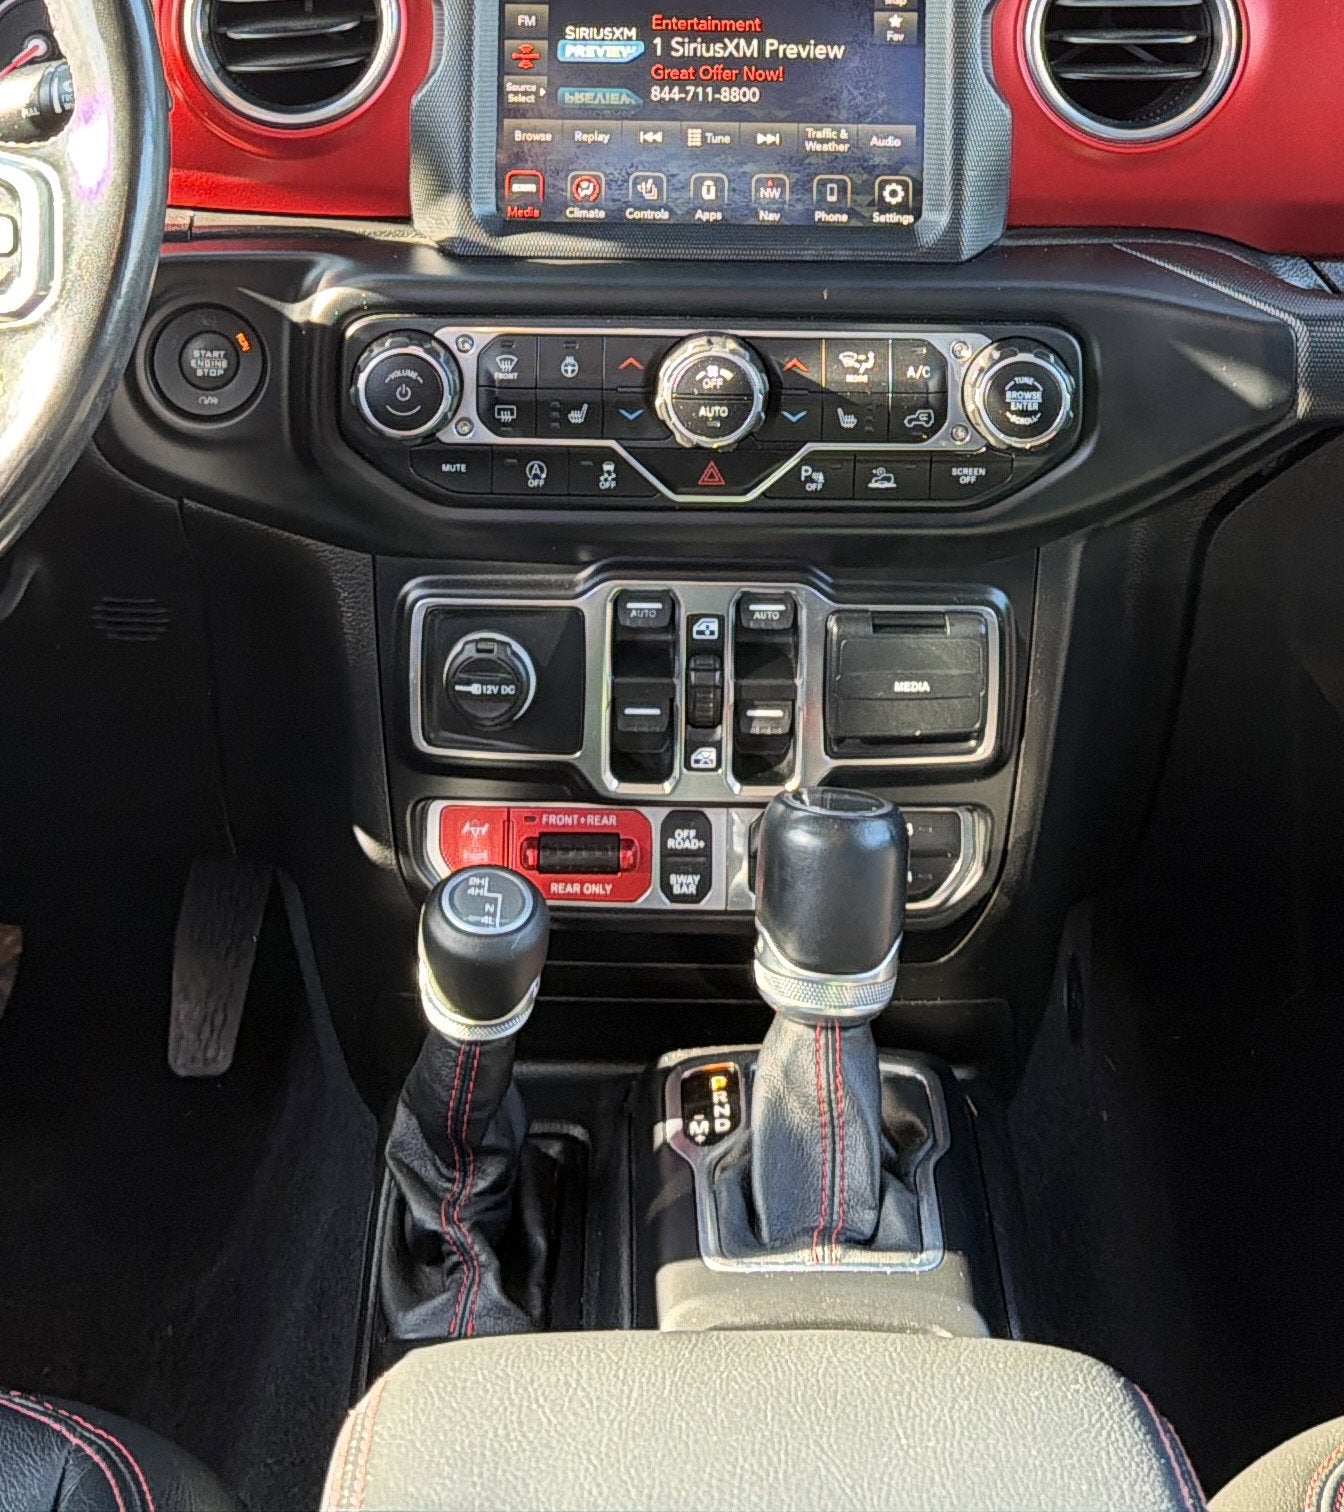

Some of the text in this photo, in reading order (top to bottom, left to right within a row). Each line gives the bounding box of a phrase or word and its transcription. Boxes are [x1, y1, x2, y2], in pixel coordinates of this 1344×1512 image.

[517, 15, 537, 27] FM
[651, 13, 763, 32] Entertainment
[886, 30, 905, 42] Fav
[652, 37, 846, 60] 1 SiriusXM Preview
[650, 64, 785, 82] Great Offer Now!
[506, 82, 537, 92] Source
[650, 85, 761, 103] 844-711-8800
[514, 129, 553, 142] Browse
[574, 130, 611, 144] Replay
[705, 133, 731, 144] Tune
[805, 128, 849, 140] Traffic &
[805, 141, 851, 153] Weather
[869, 136, 902, 148] Audio
[507, 206, 541, 219] Media
[565, 207, 606, 219] Climate
[625, 208, 670, 220] Controls
[694, 209, 723, 223] Apps
[758, 210, 781, 222] Nav
[814, 210, 849, 223] Phone
[872, 211, 915, 226] Settings
[193, 349, 226, 358] START
[190, 359, 228, 368] ENGINE
[196, 369, 225, 377] STOP
[493, 372, 519, 380] FRONT
[906, 365, 932, 380] A/C
[702, 379, 724, 389] OFF
[1006, 390, 1043, 400] BROWSE
[698, 405, 729, 417] AUTO
[1010, 401, 1039, 411] ENTER
[441, 464, 467, 473] MUTE
[951, 467, 986, 476] SCREEN
[528, 479, 546, 488] OFF
[599, 480, 617, 489] OFF
[959, 476, 978, 485] OFF
[805, 482, 824, 492] OFF
[630, 609, 657, 619] AUTO
[753, 610, 780, 620] AUTO
[482, 684, 499, 695] 12V
[894, 680, 931, 693] MEDIA
[674, 829, 697, 839] OFF
[550, 882, 613, 895] REAR ONLY
[673, 884, 697, 895] BAR
[484, 902, 495, 914] N
[711, 1076, 728, 1090] P
[712, 1091, 729, 1104] R
[713, 1103, 731, 1118] N
[689, 1120, 709, 1135] M
[714, 1118, 731, 1133] D
